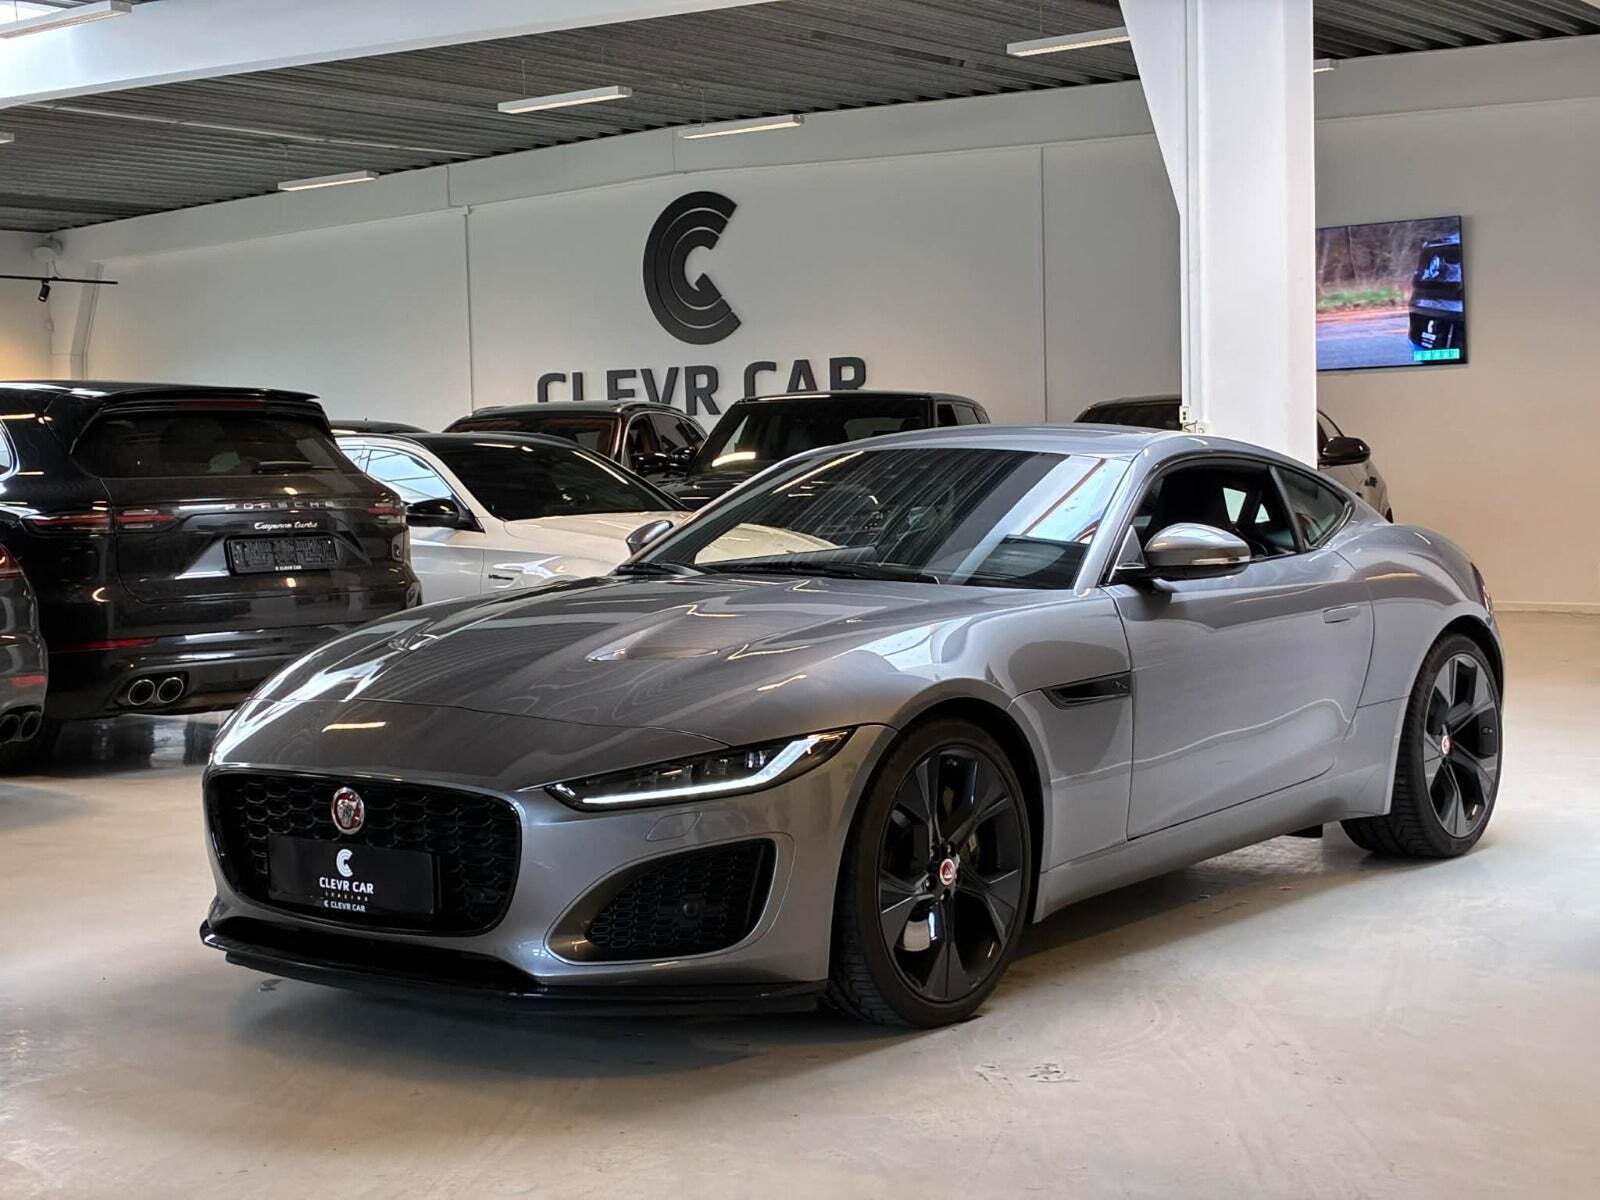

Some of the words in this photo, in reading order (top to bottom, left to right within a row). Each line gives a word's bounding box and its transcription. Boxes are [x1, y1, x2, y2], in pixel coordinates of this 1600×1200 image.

[537, 365, 721, 416] CLEVR
[743, 357, 867, 398] CAR
[319, 877, 350, 891] CLEVR
[352, 881, 374, 895] CAR
[330, 901, 350, 910] CLEVR
[352, 904, 366, 912] CAR
